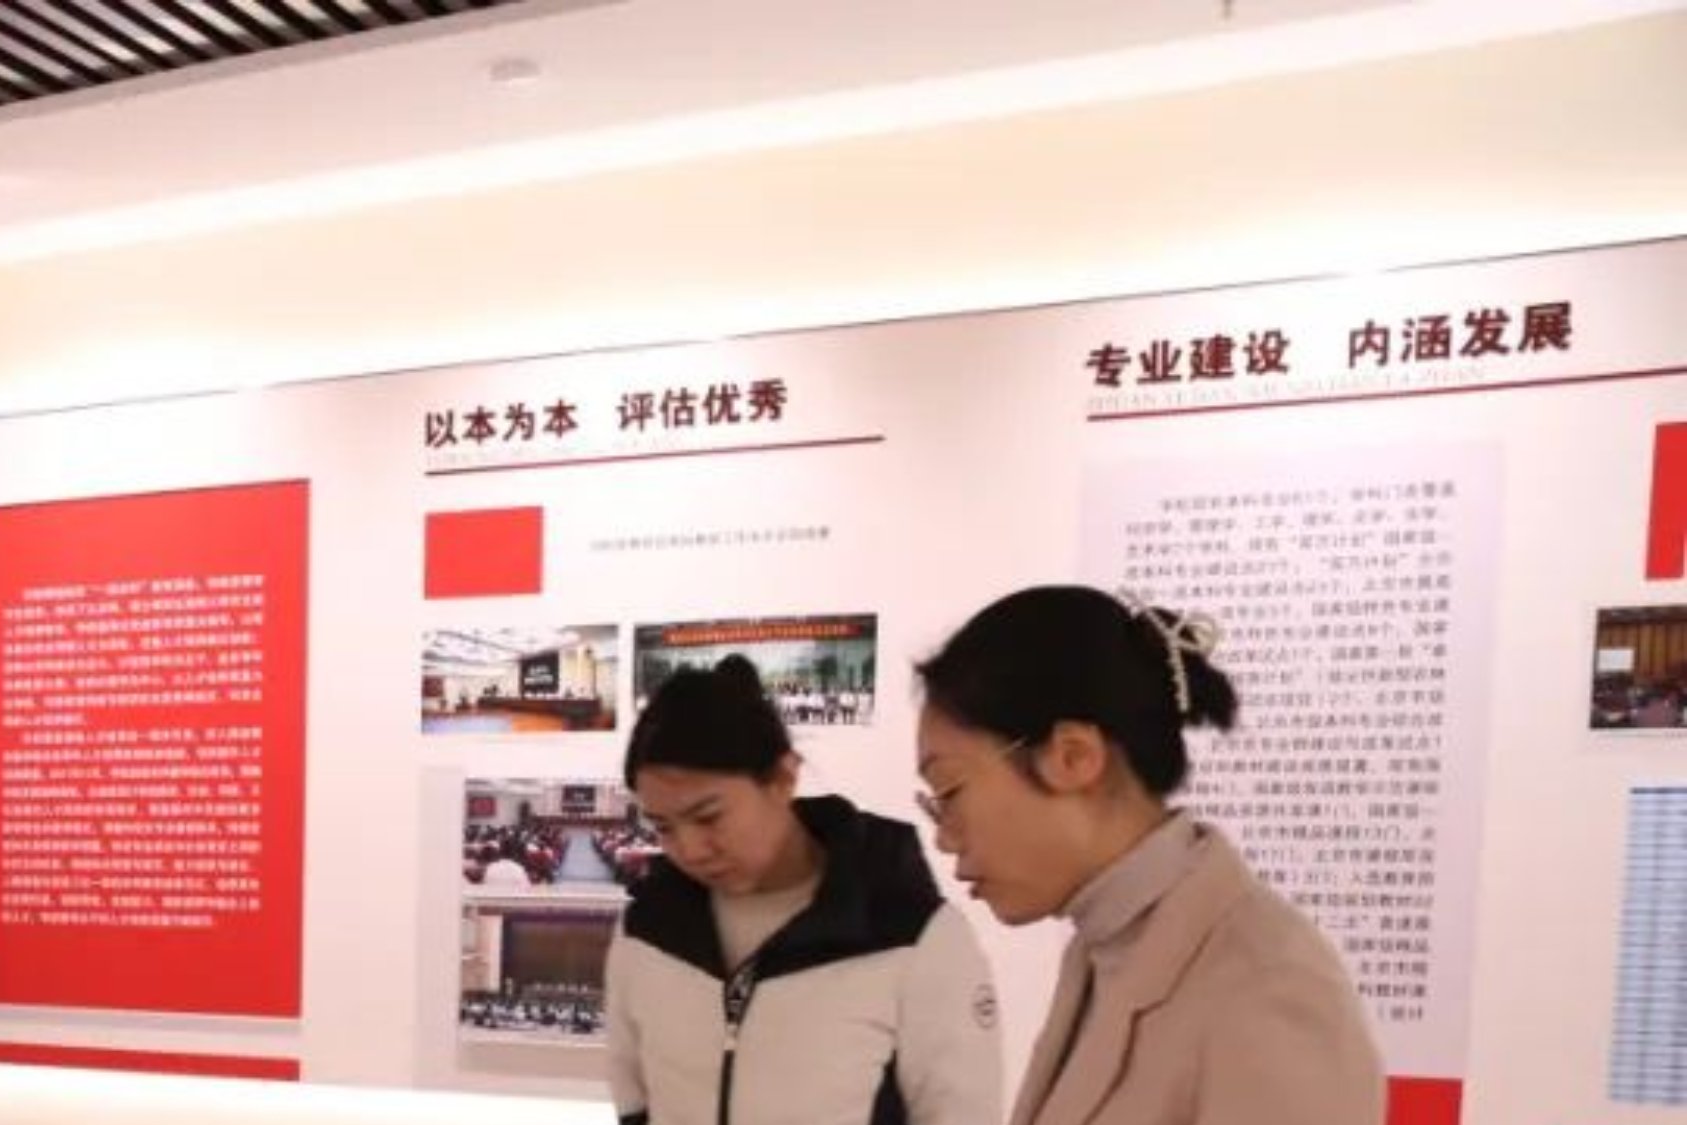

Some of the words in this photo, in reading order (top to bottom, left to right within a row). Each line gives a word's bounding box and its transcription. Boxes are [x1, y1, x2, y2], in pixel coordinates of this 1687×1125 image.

[1085, 330, 1290, 388] 专业建设
[1348, 302, 1573, 368] 内涵发展
[424, 398, 578, 448] 以本为本
[616, 377, 788, 432] 评估优秀
